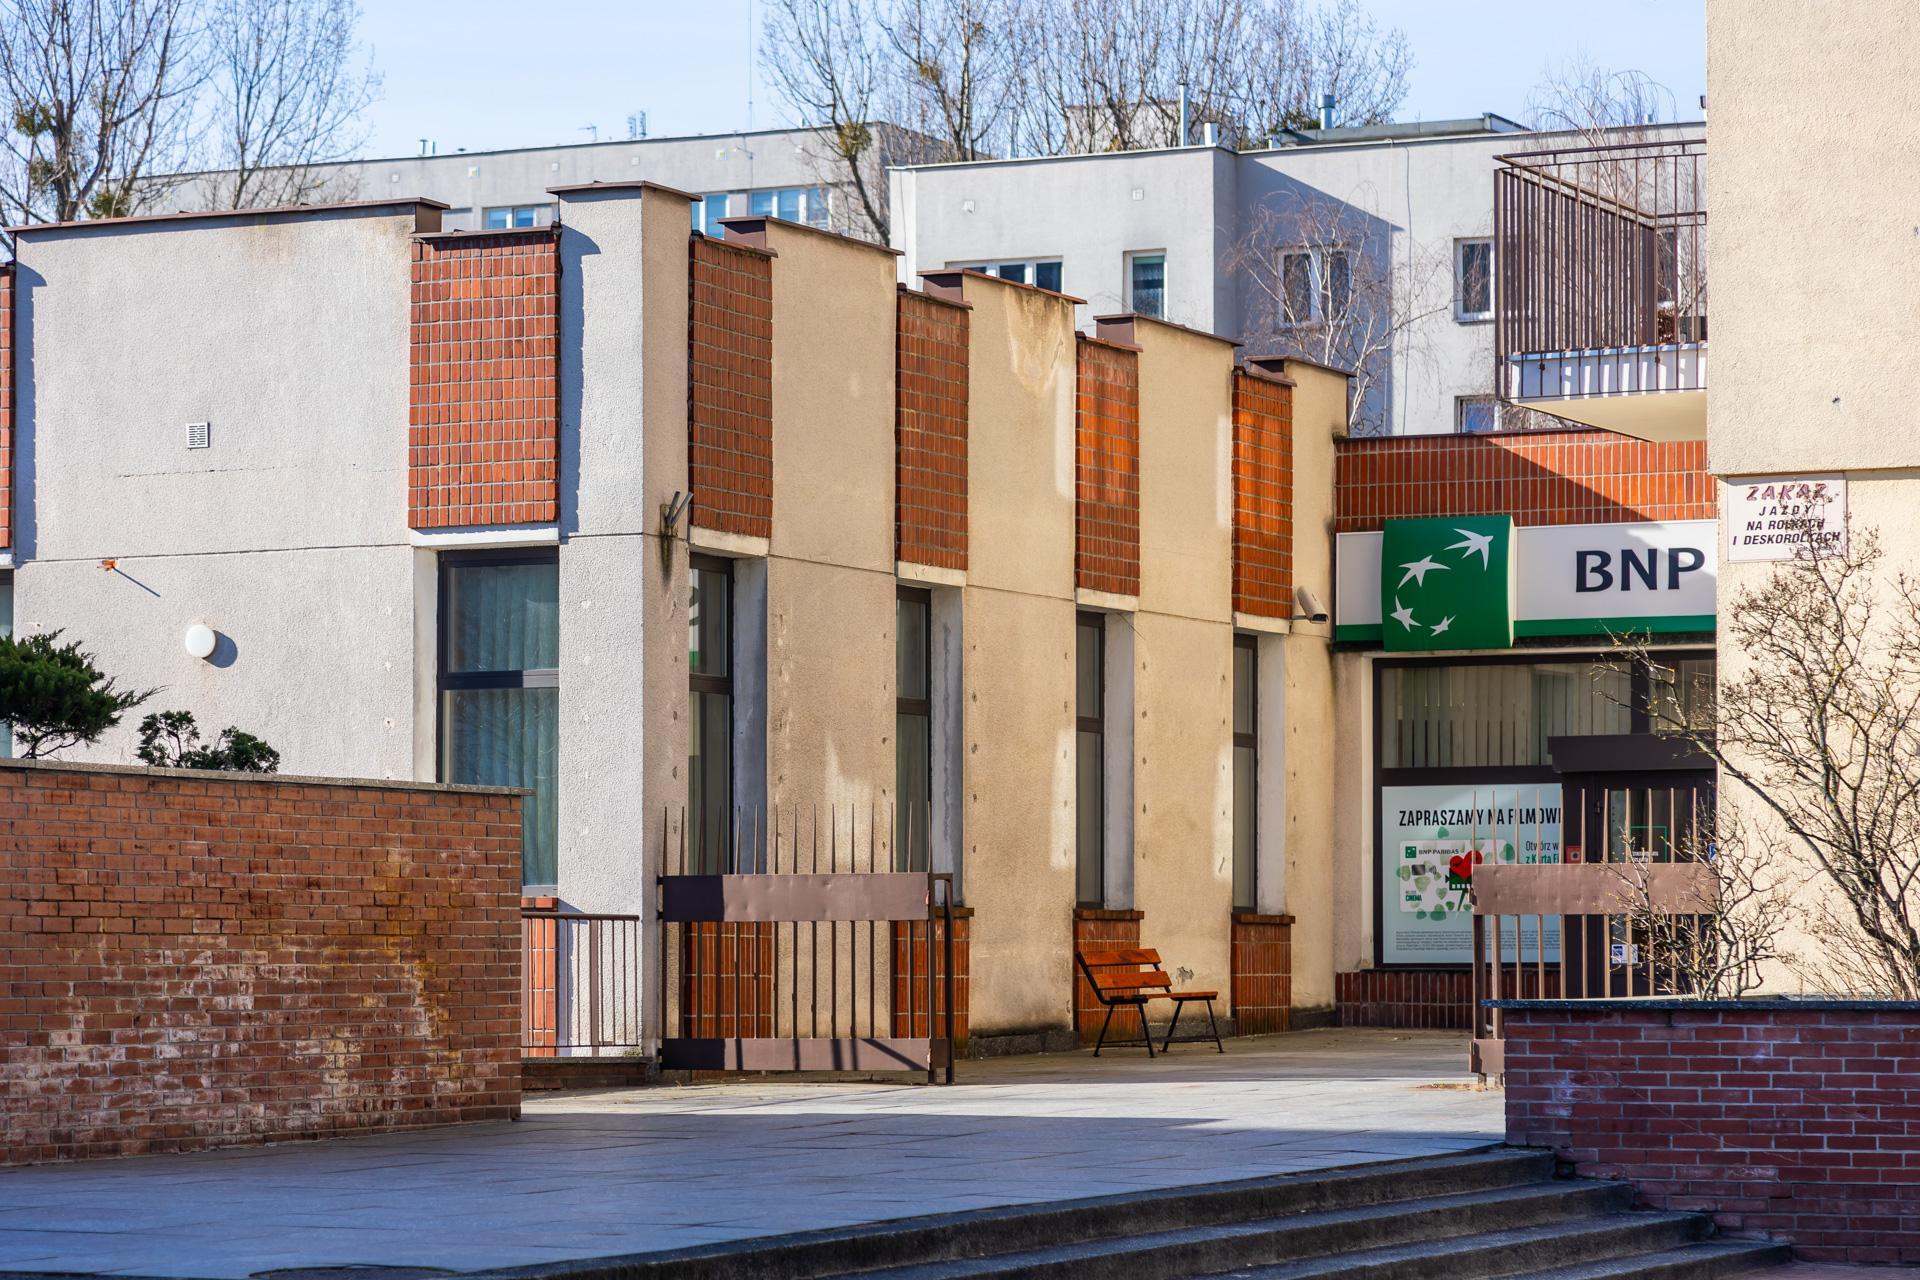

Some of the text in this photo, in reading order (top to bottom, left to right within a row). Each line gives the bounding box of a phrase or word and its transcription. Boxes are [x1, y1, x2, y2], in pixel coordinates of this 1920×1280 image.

[1746, 483, 1827, 501] ZAKAZ
[1758, 504, 1812, 516] JAZDY
[1746, 518, 1825, 531] NA ROLKACH
[1732, 531, 1841, 546] I DESKOROLKACH
[1576, 547, 1705, 593] BNP
[1399, 808, 1484, 827] ZAPRASZAMY
[1488, 808, 1505, 825] NA
